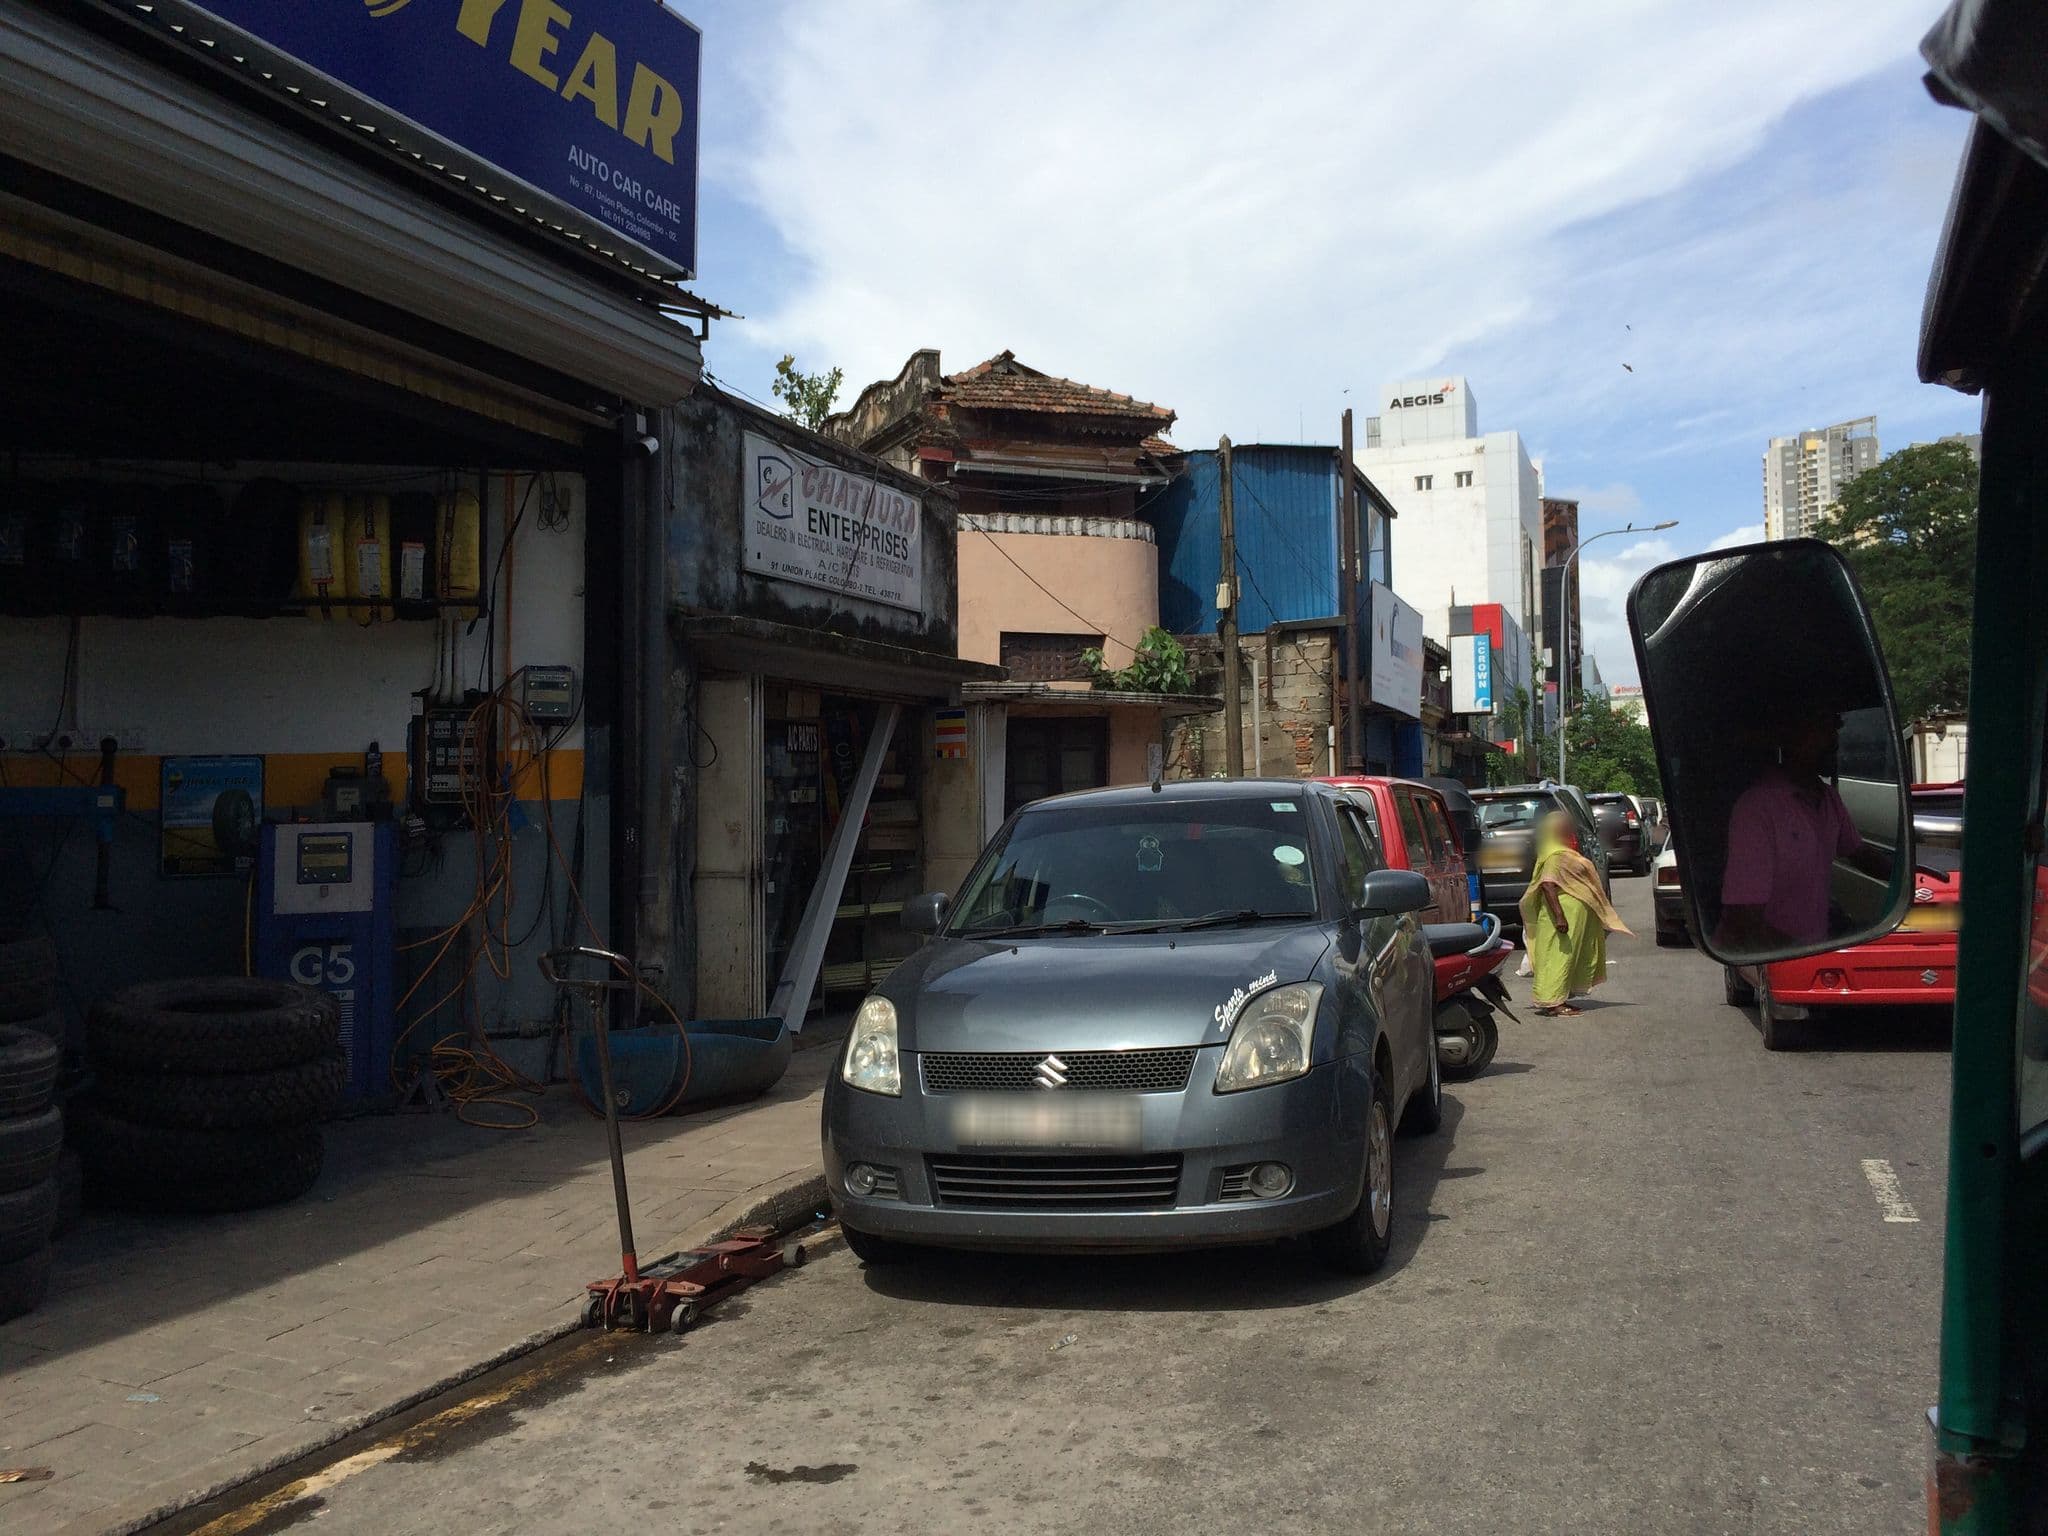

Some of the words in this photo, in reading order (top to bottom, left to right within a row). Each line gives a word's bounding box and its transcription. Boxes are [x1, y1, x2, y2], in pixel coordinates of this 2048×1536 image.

[568, 144, 609, 182] AUTO
[612, 170, 642, 202] CAR
[645, 188, 681, 225] CARE
[596, 189, 616, 208] Union
[637, 211, 665, 235] Colombo
[612, 212, 625, 227] 011
[1390, 393, 1445, 409] AEGIS
[756, 520, 788, 542] DEALERS
[789, 530, 797, 544] IN
[797, 531, 835, 556] ELECTRICAL
[808, 507, 909, 561] ENTERPRISES
[782, 563, 804, 576] UNION
[805, 569, 827, 583] PLACE
[818, 559, 840, 574] A/C
[1477, 646, 1488, 688] CROWN
[290, 944, 355, 987] G5
[1215, 988, 1243, 1032] Sports
